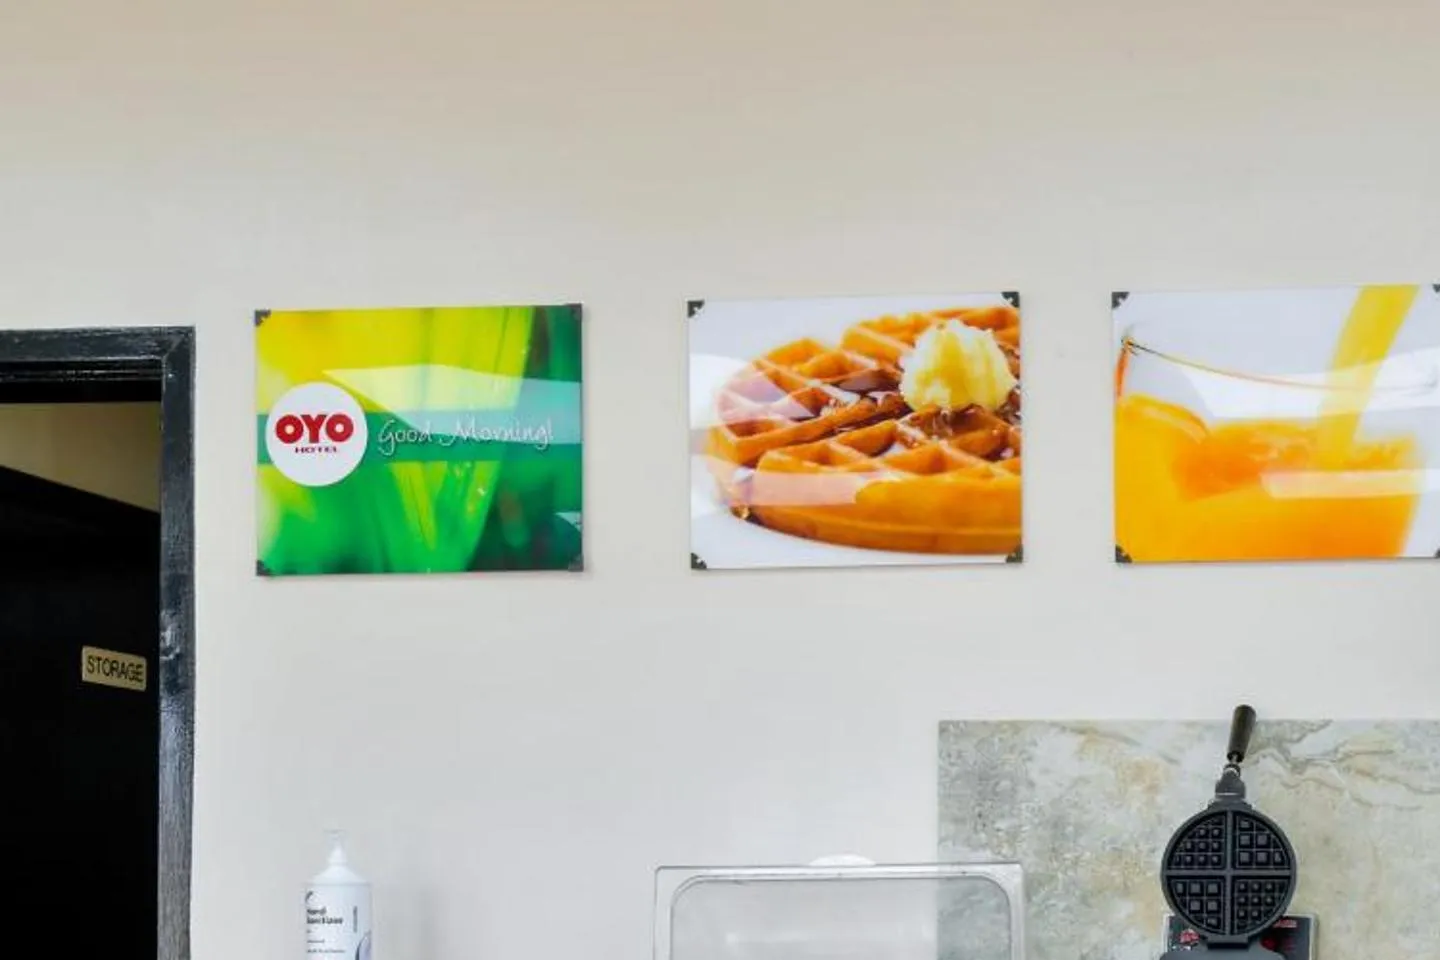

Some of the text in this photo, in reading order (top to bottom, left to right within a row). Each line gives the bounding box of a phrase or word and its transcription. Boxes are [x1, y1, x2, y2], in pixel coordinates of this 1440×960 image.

[276, 414, 354, 443] OYO
[378, 414, 554, 456] Good Morning!
[86, 655, 144, 683] STORAGE
